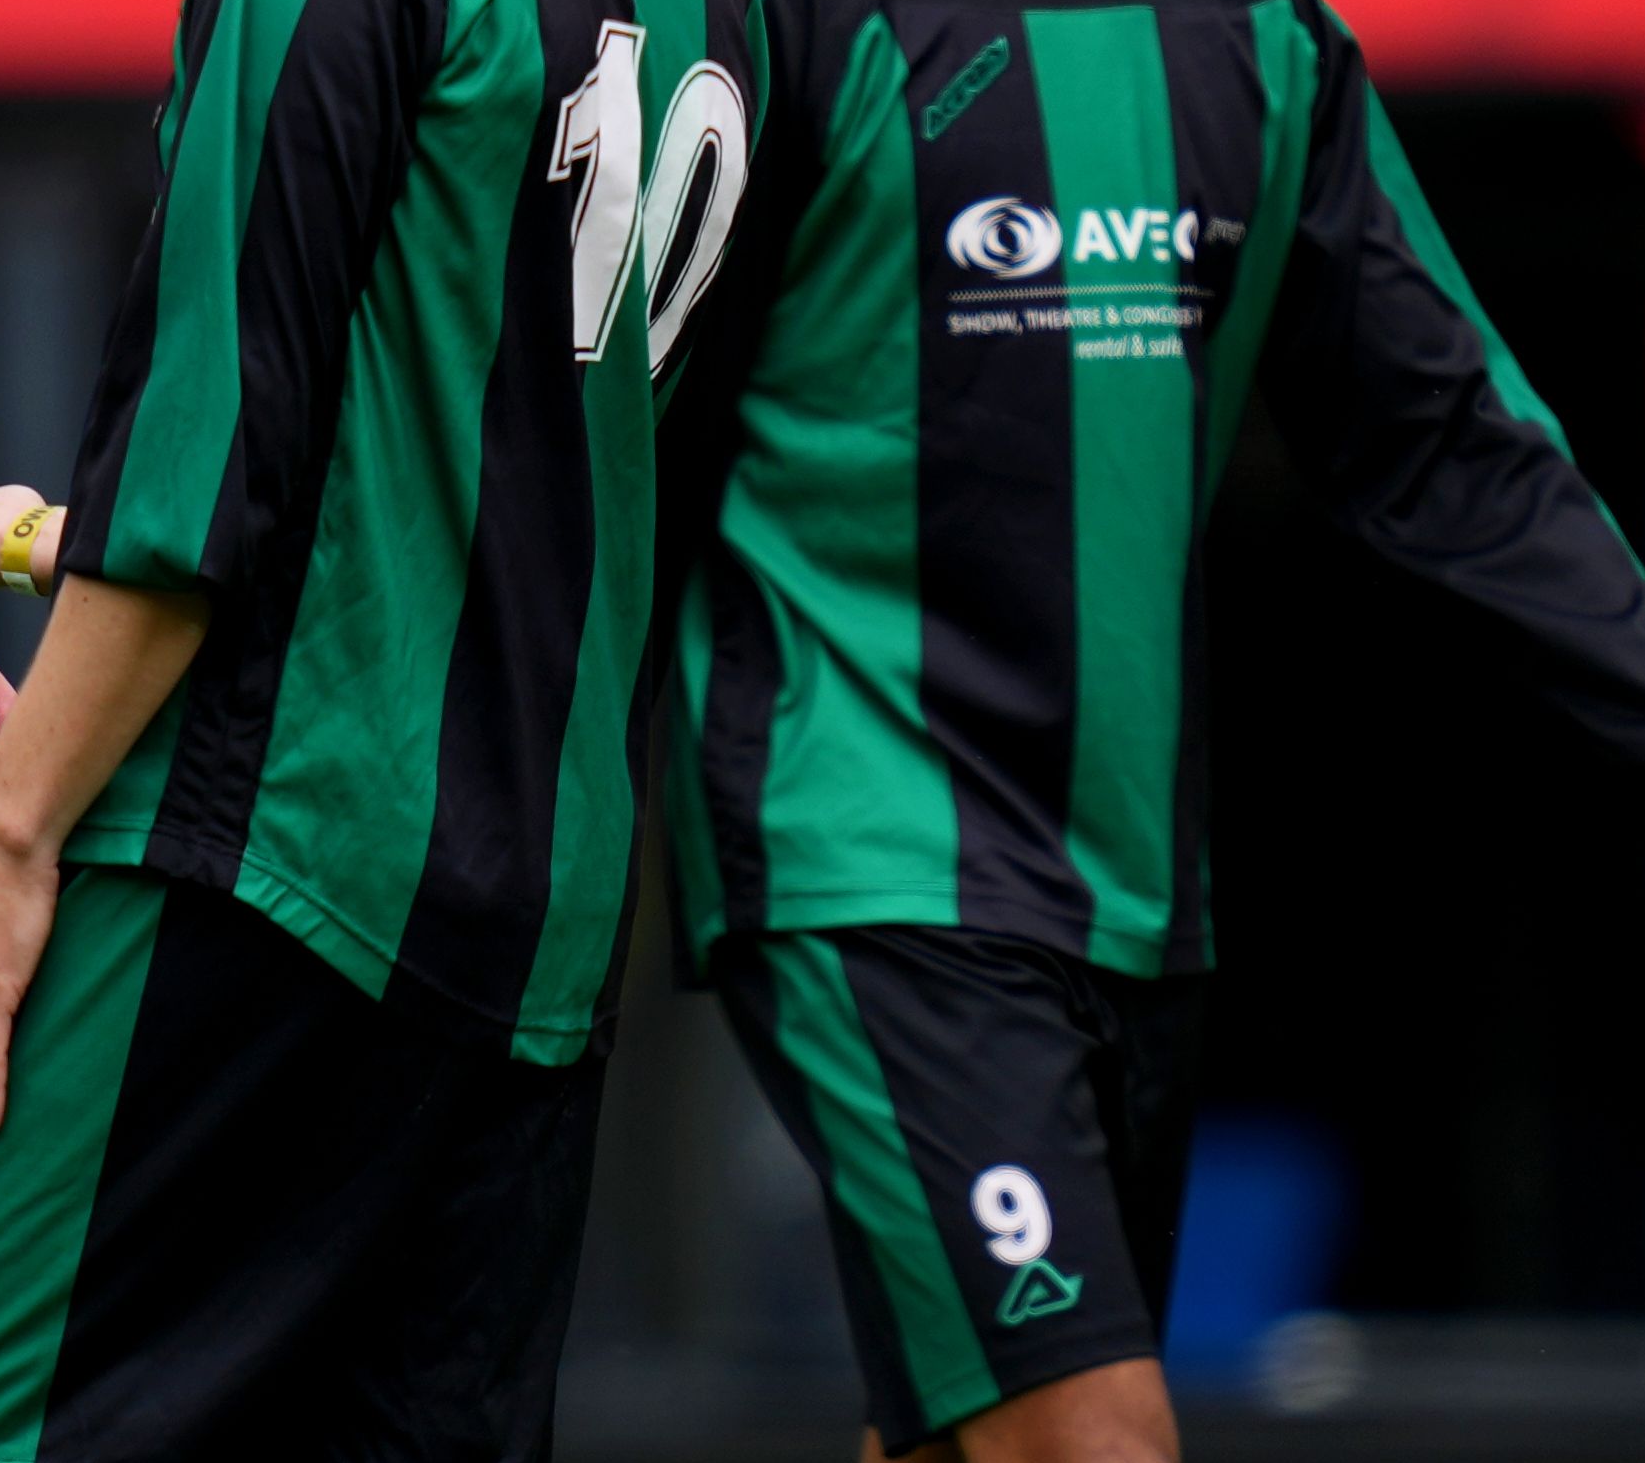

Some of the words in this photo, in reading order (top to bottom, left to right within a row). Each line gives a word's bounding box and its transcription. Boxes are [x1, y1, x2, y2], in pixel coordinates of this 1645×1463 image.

[546, 19, 750, 381] 10
[1105, 304, 1121, 328] &
[1130, 333, 1145, 358] &
[970, 1163, 1053, 1266] 9
